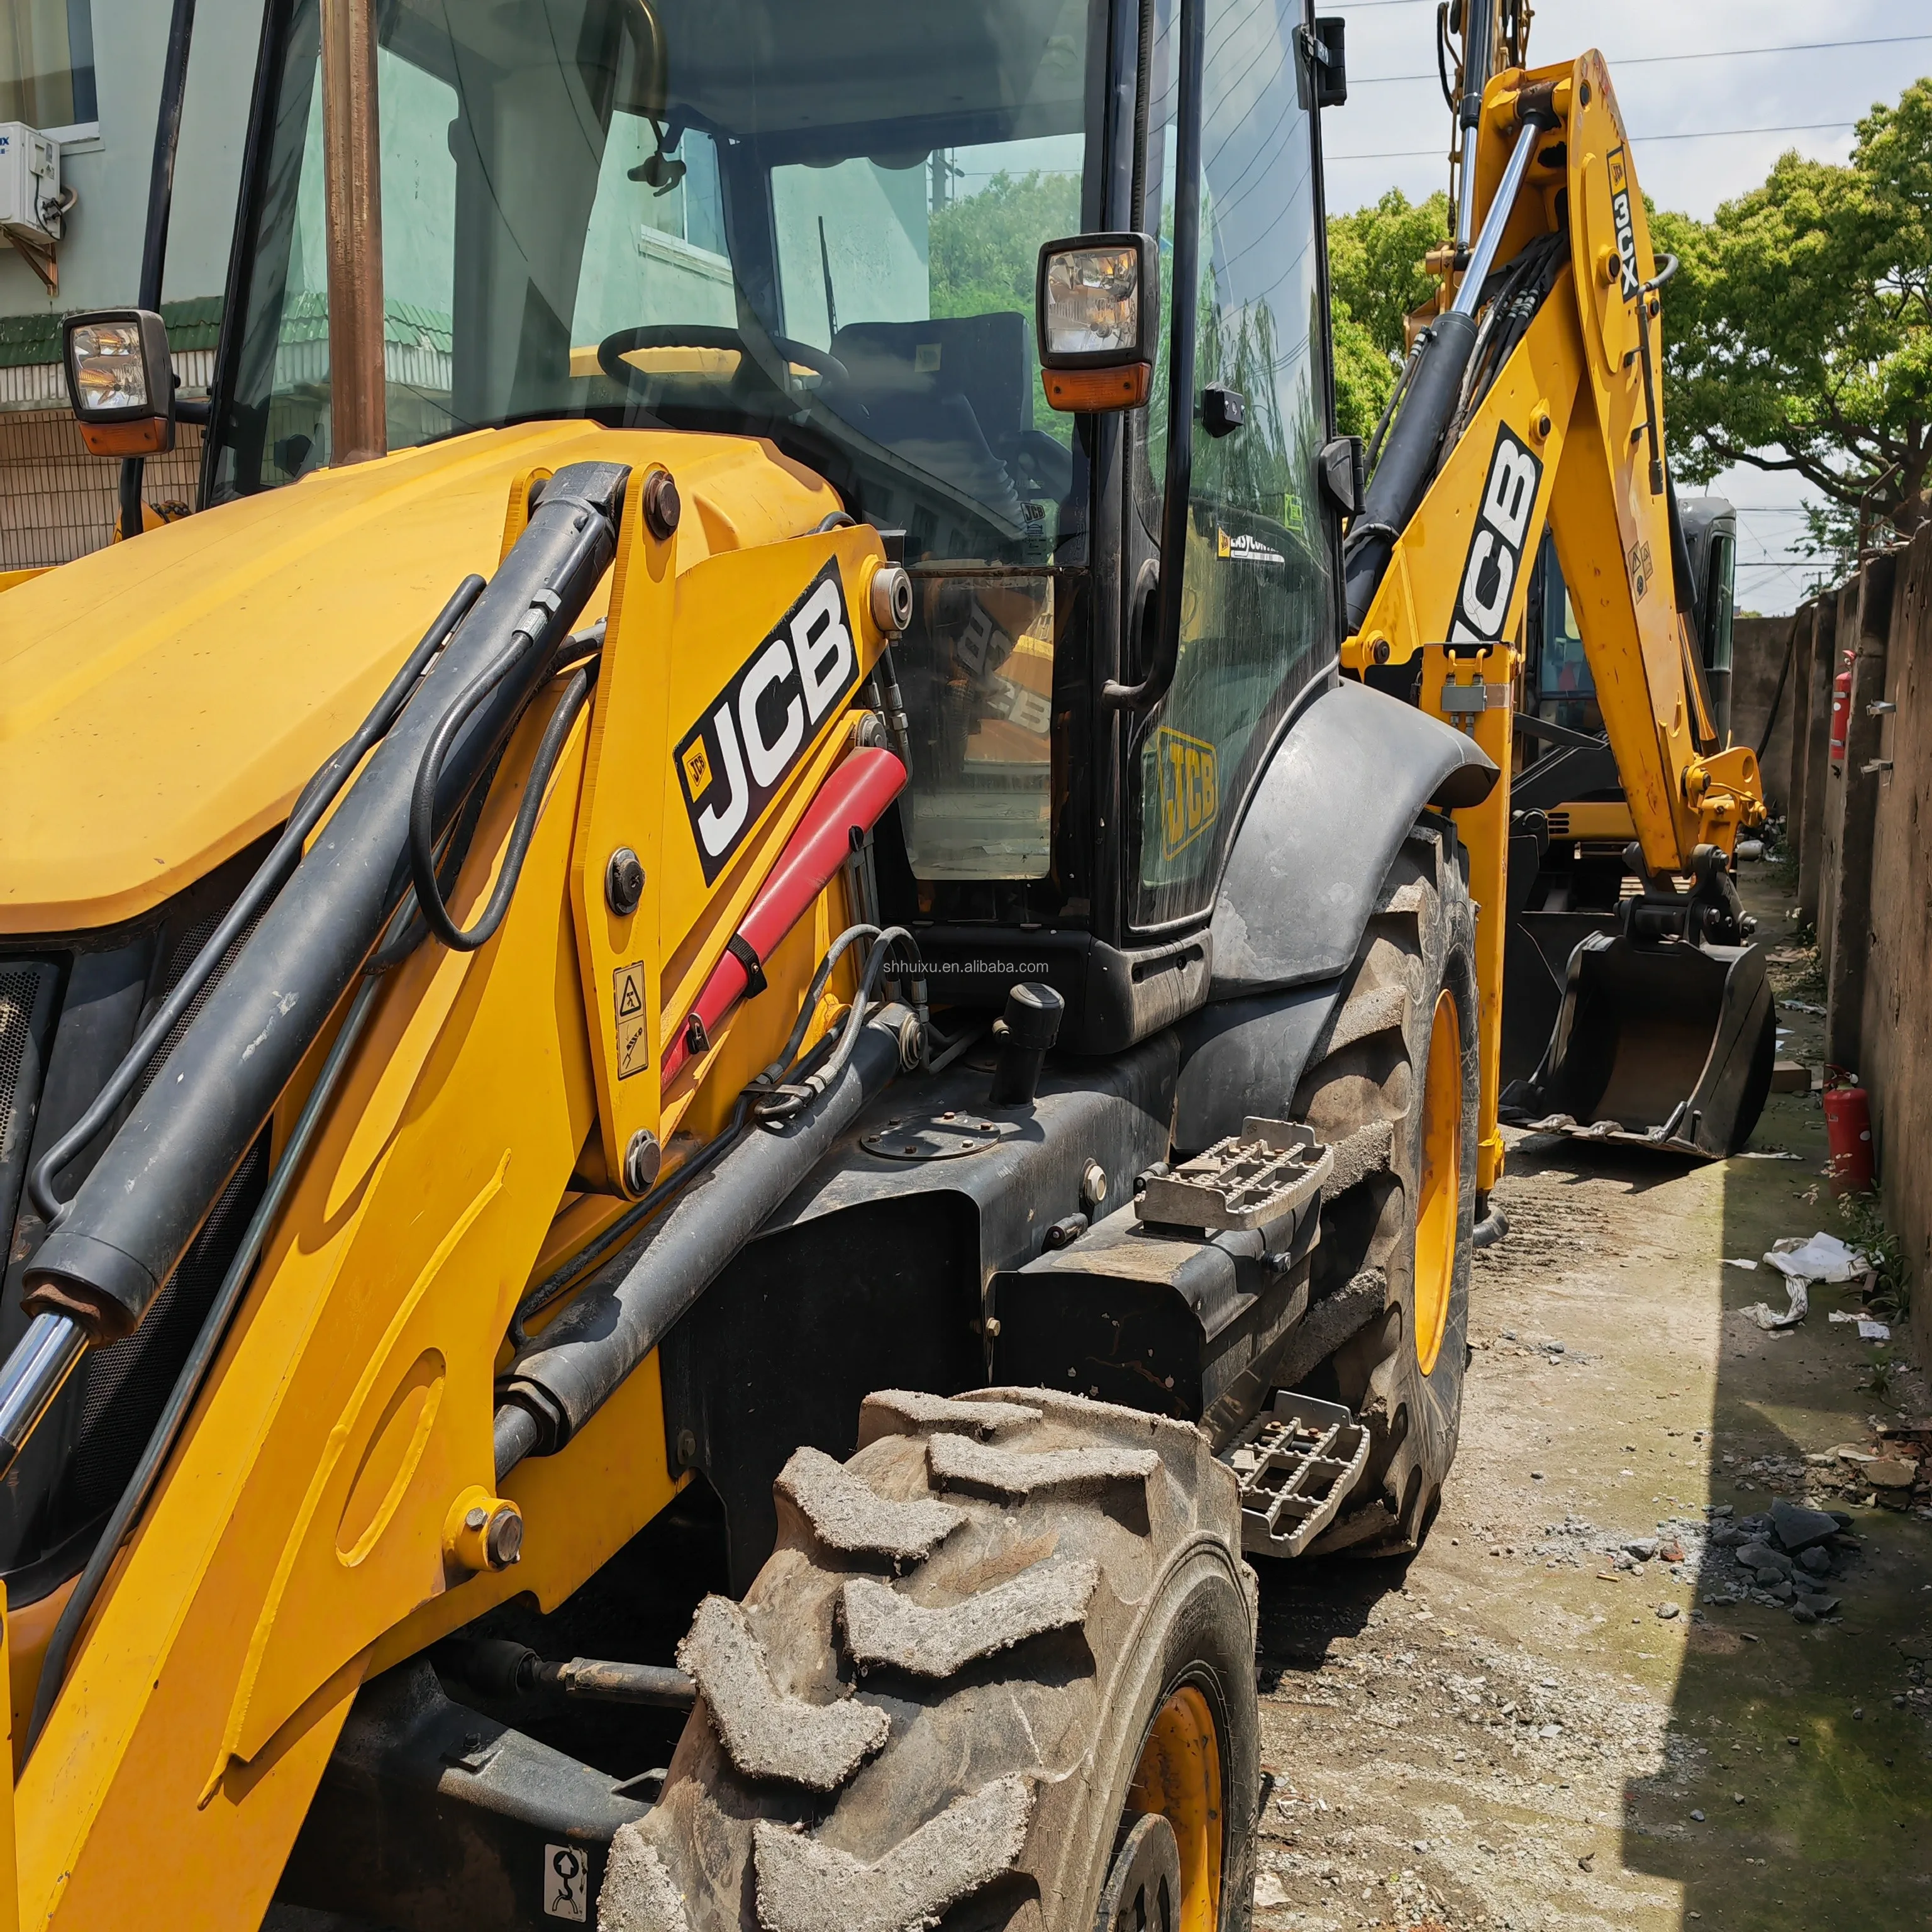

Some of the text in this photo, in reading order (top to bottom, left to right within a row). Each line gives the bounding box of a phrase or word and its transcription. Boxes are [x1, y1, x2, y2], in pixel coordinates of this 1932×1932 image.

[1614, 194, 1638, 294] 3CX
[1024, 504, 1044, 521] JCB
[1452, 439, 1536, 642] CB
[690, 755, 705, 783] JCB
[697, 579, 852, 857] JCB
[1167, 741, 1214, 845] JCB
